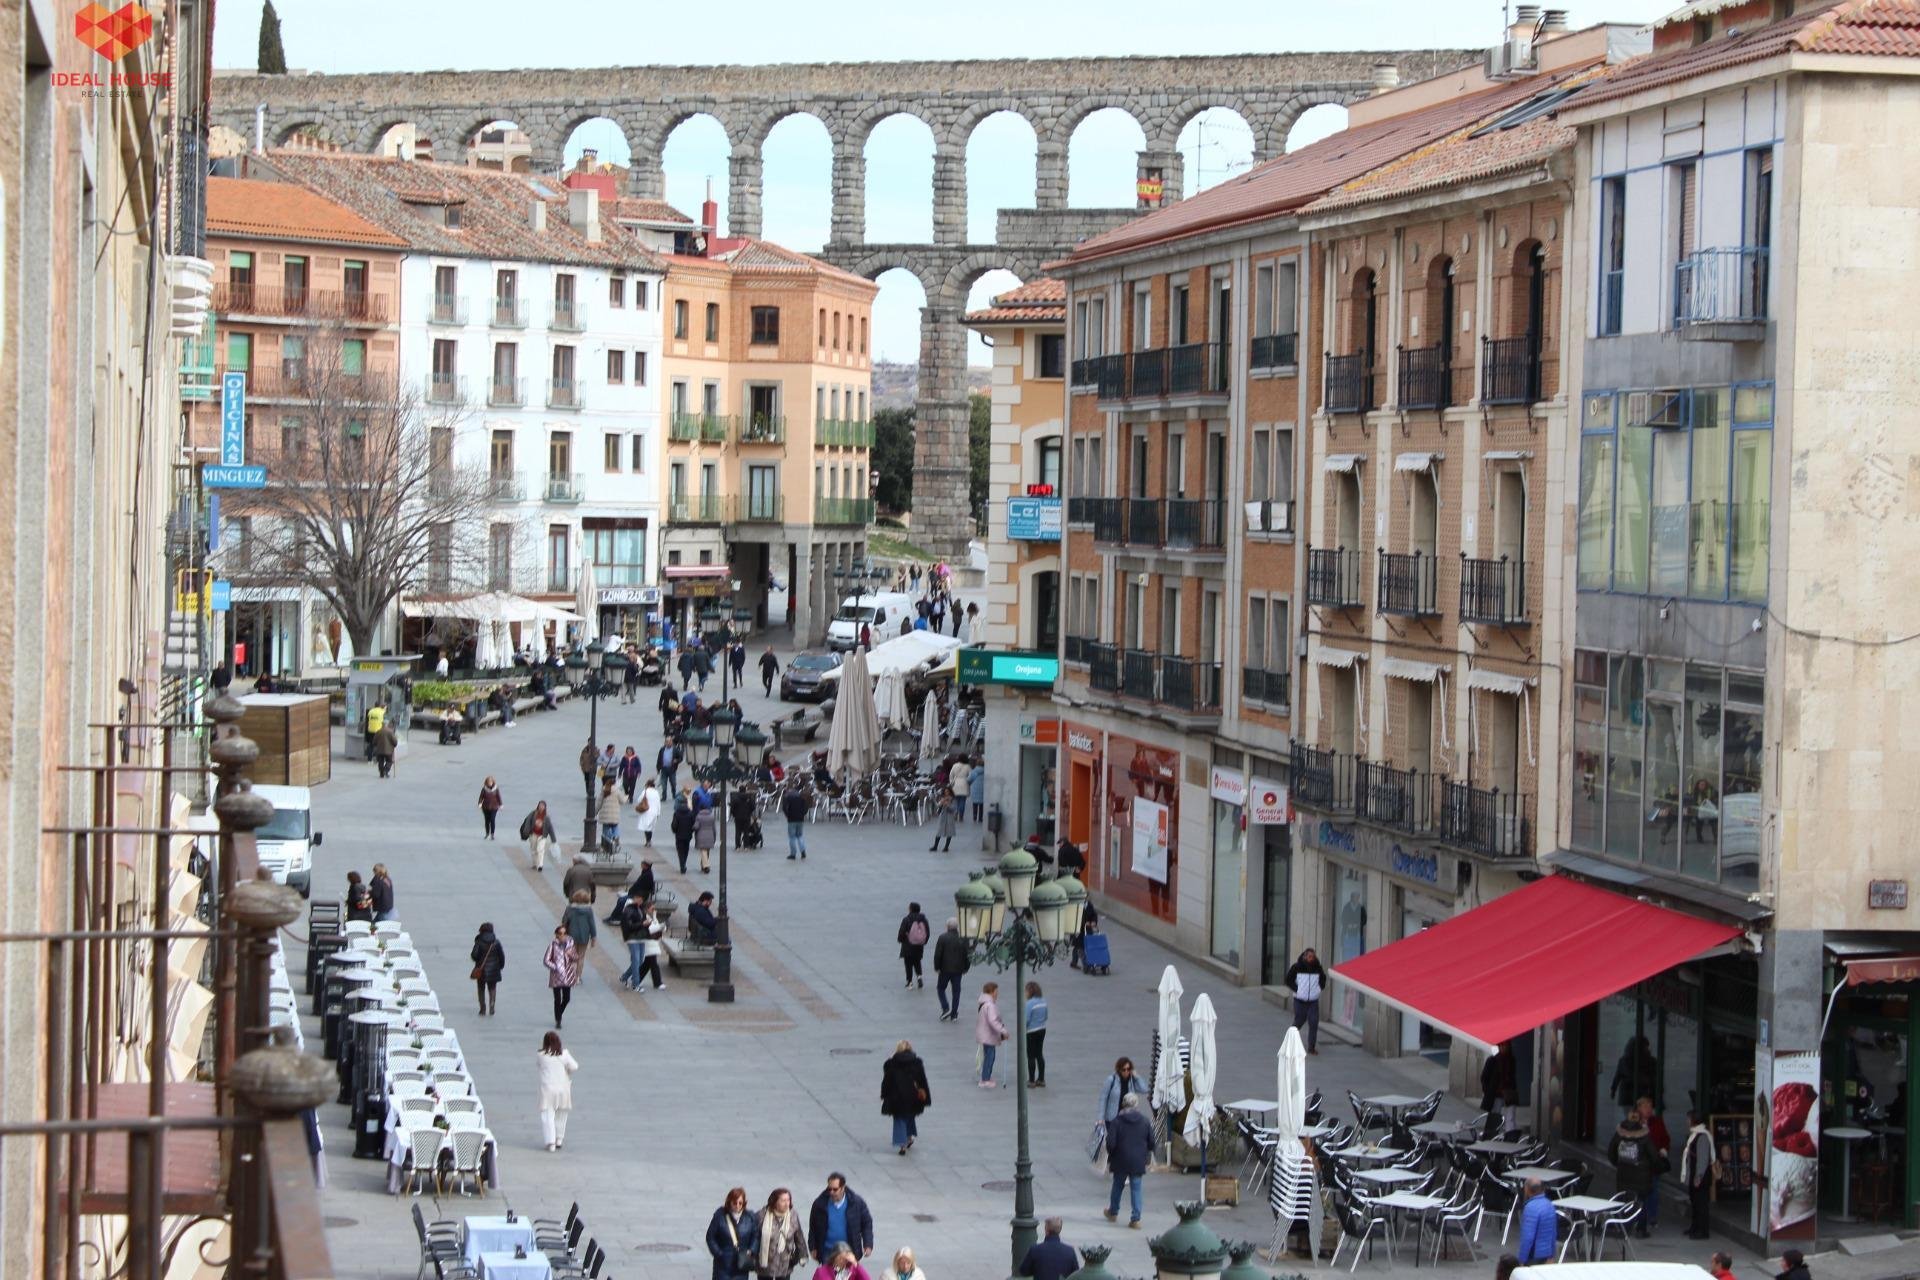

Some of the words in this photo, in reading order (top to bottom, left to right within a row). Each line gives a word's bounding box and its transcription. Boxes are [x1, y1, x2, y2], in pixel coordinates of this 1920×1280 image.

[226, 377, 242, 464] OFICINAS
[203, 466, 264, 483] MINGUEZ
[963, 668, 988, 677] OREJANA
[1015, 664, 1042, 677] Orejana
[1256, 807, 1284, 815] General
